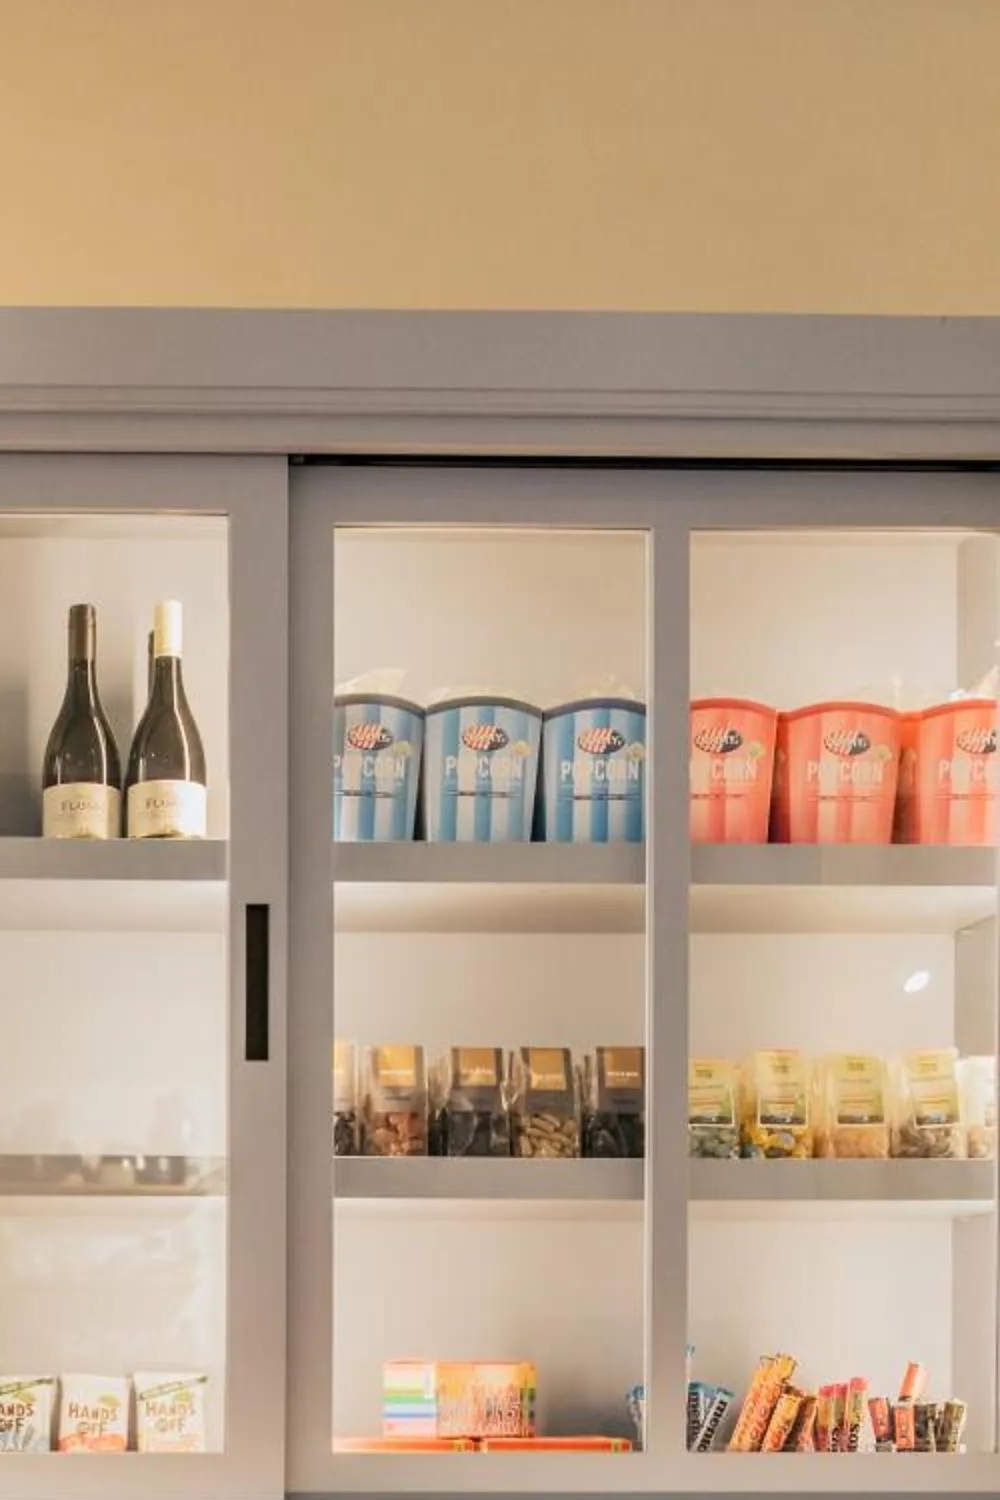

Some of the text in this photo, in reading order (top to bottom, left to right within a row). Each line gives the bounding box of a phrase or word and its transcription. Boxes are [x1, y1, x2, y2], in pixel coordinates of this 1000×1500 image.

[560, 760, 639, 781] POPCORN
[69, 1402, 117, 1419] HANDS
[146, 1401, 195, 1417] HANDS
[697, 1399, 728, 1452] mento
